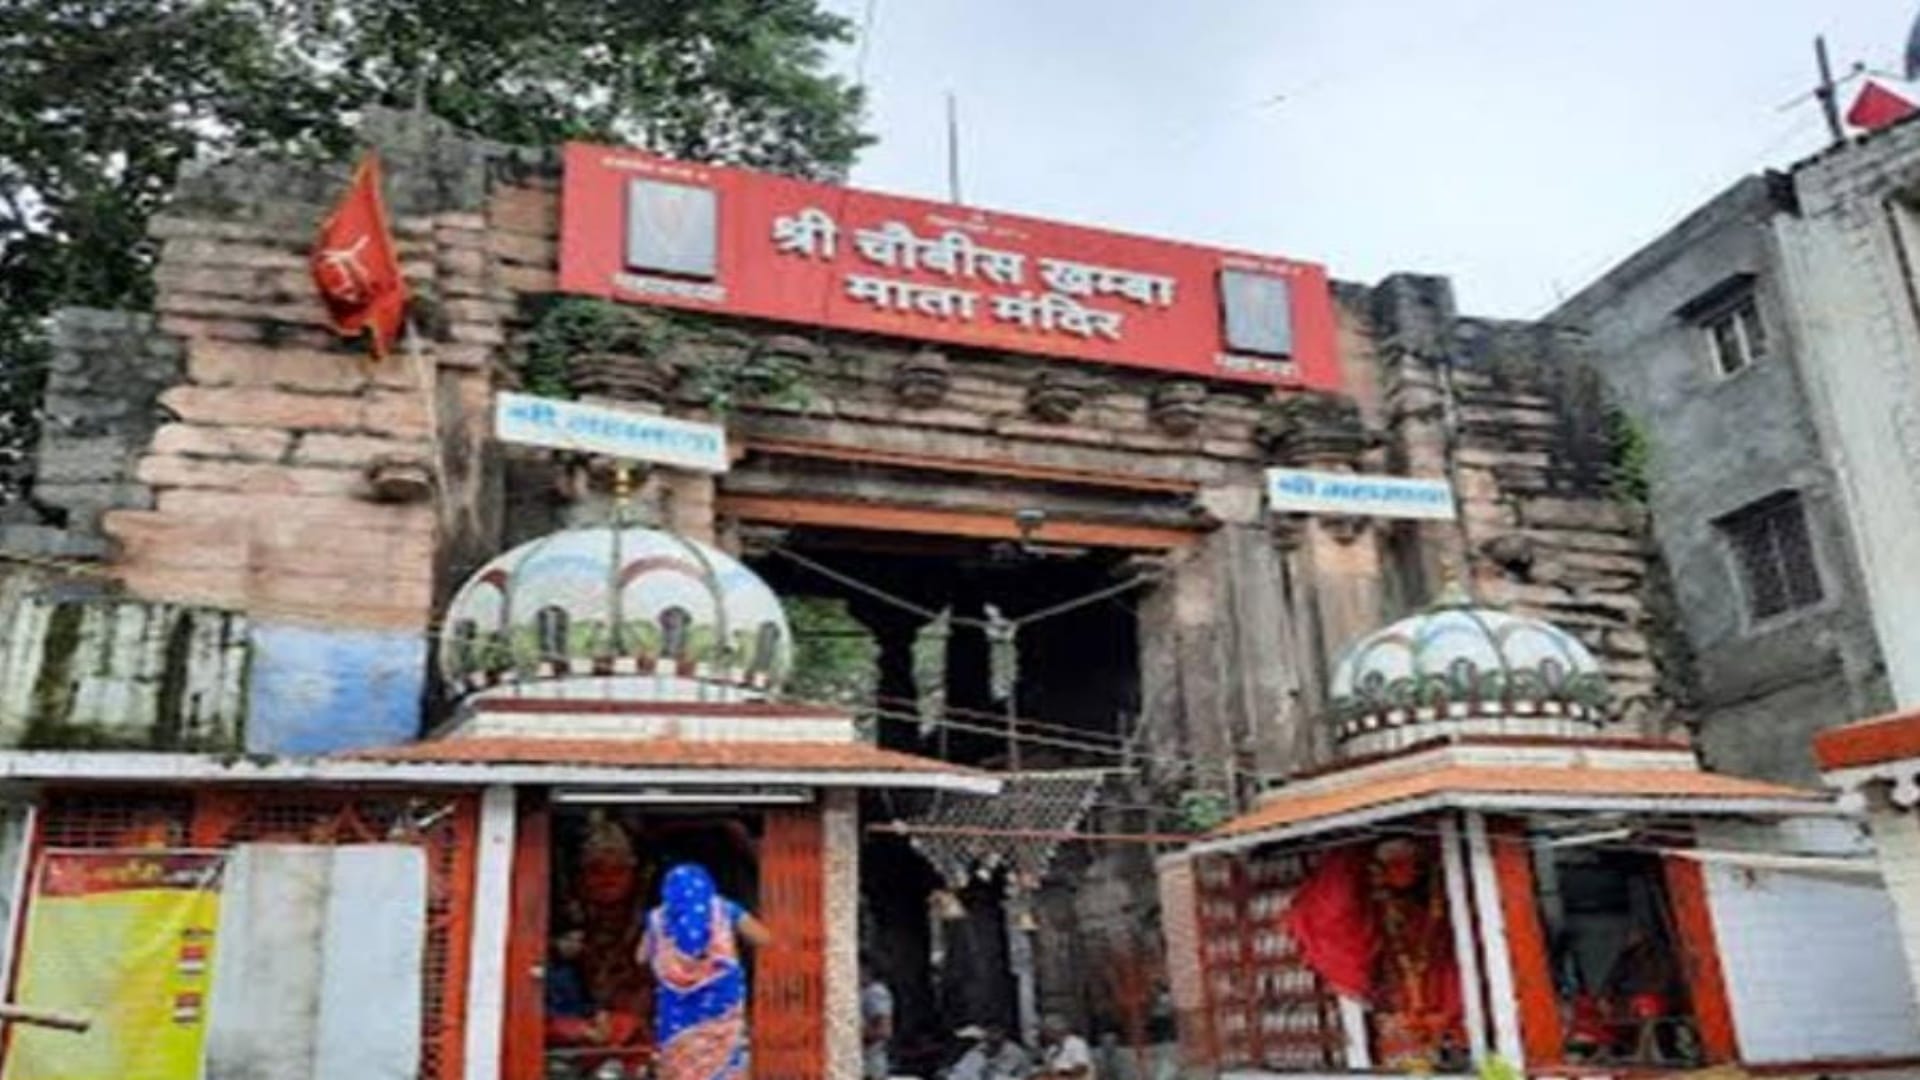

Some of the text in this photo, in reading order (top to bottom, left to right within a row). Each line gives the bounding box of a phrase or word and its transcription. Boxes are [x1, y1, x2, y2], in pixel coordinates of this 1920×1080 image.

[772, 208, 837, 258] श्री
[854, 222, 1026, 284] चौबीस
[1041, 256, 1177, 306] खम्बा
[844, 273, 1123, 339] माता मंदिर
